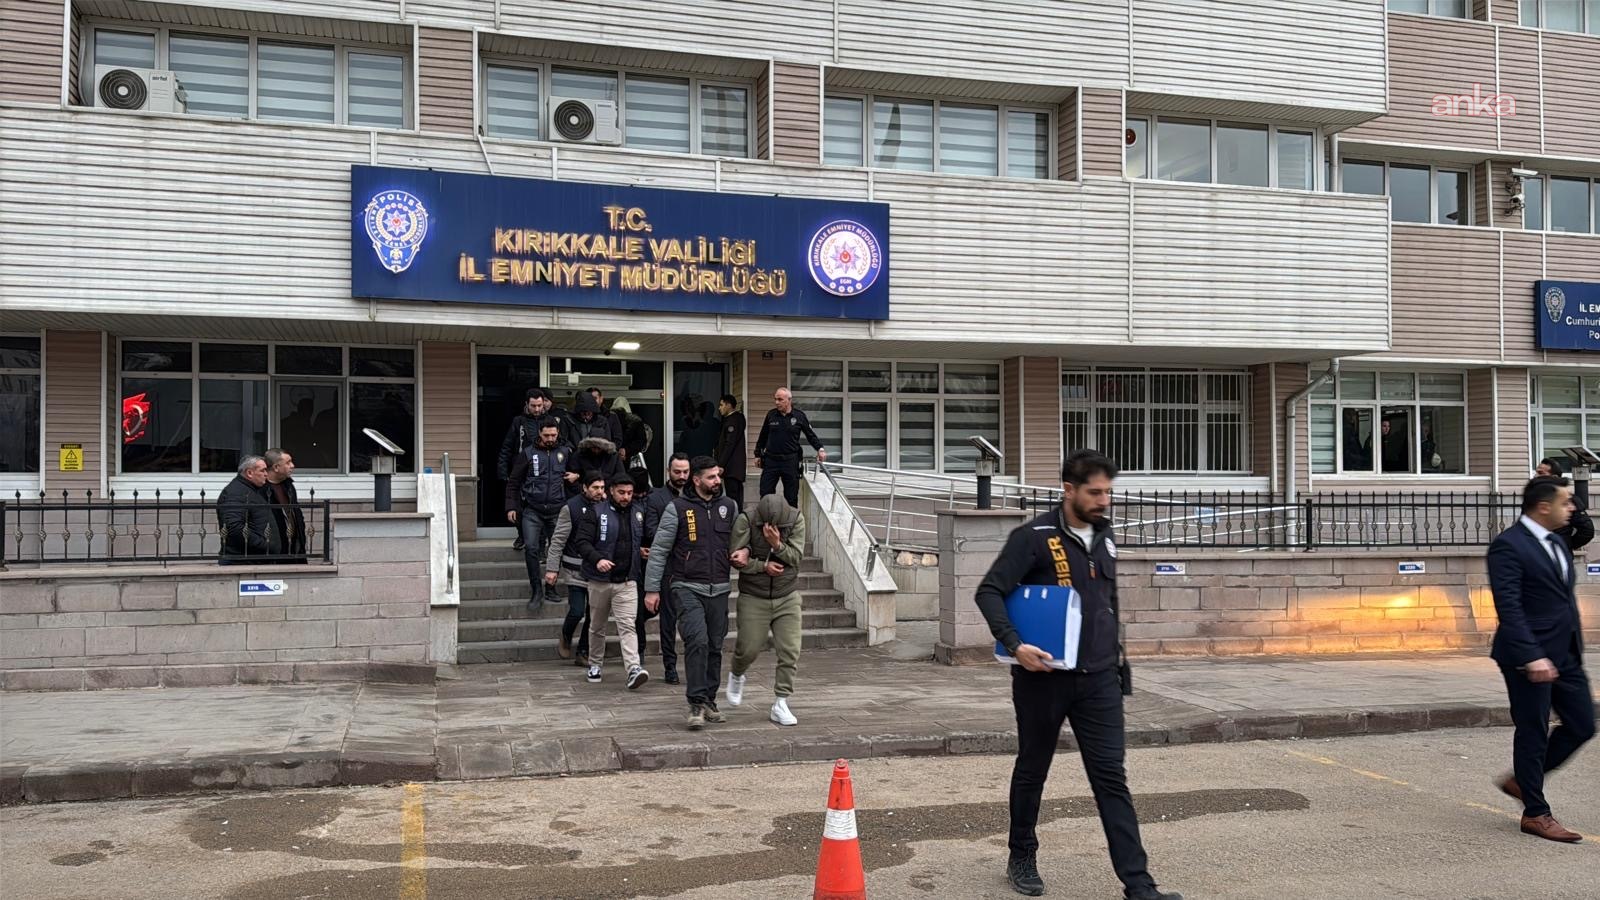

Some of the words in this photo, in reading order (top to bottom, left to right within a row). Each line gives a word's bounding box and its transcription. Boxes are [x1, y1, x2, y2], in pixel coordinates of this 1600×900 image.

[379, 193, 415, 206] POLİS
[604, 206, 653, 233] T.C.
[649, 236, 758, 267] VALİLİĞİ
[459, 253, 487, 282] İL
[489, 258, 617, 290] EMNİYET
[620, 263, 788, 296] MÜDÜRLÜĞÜ
